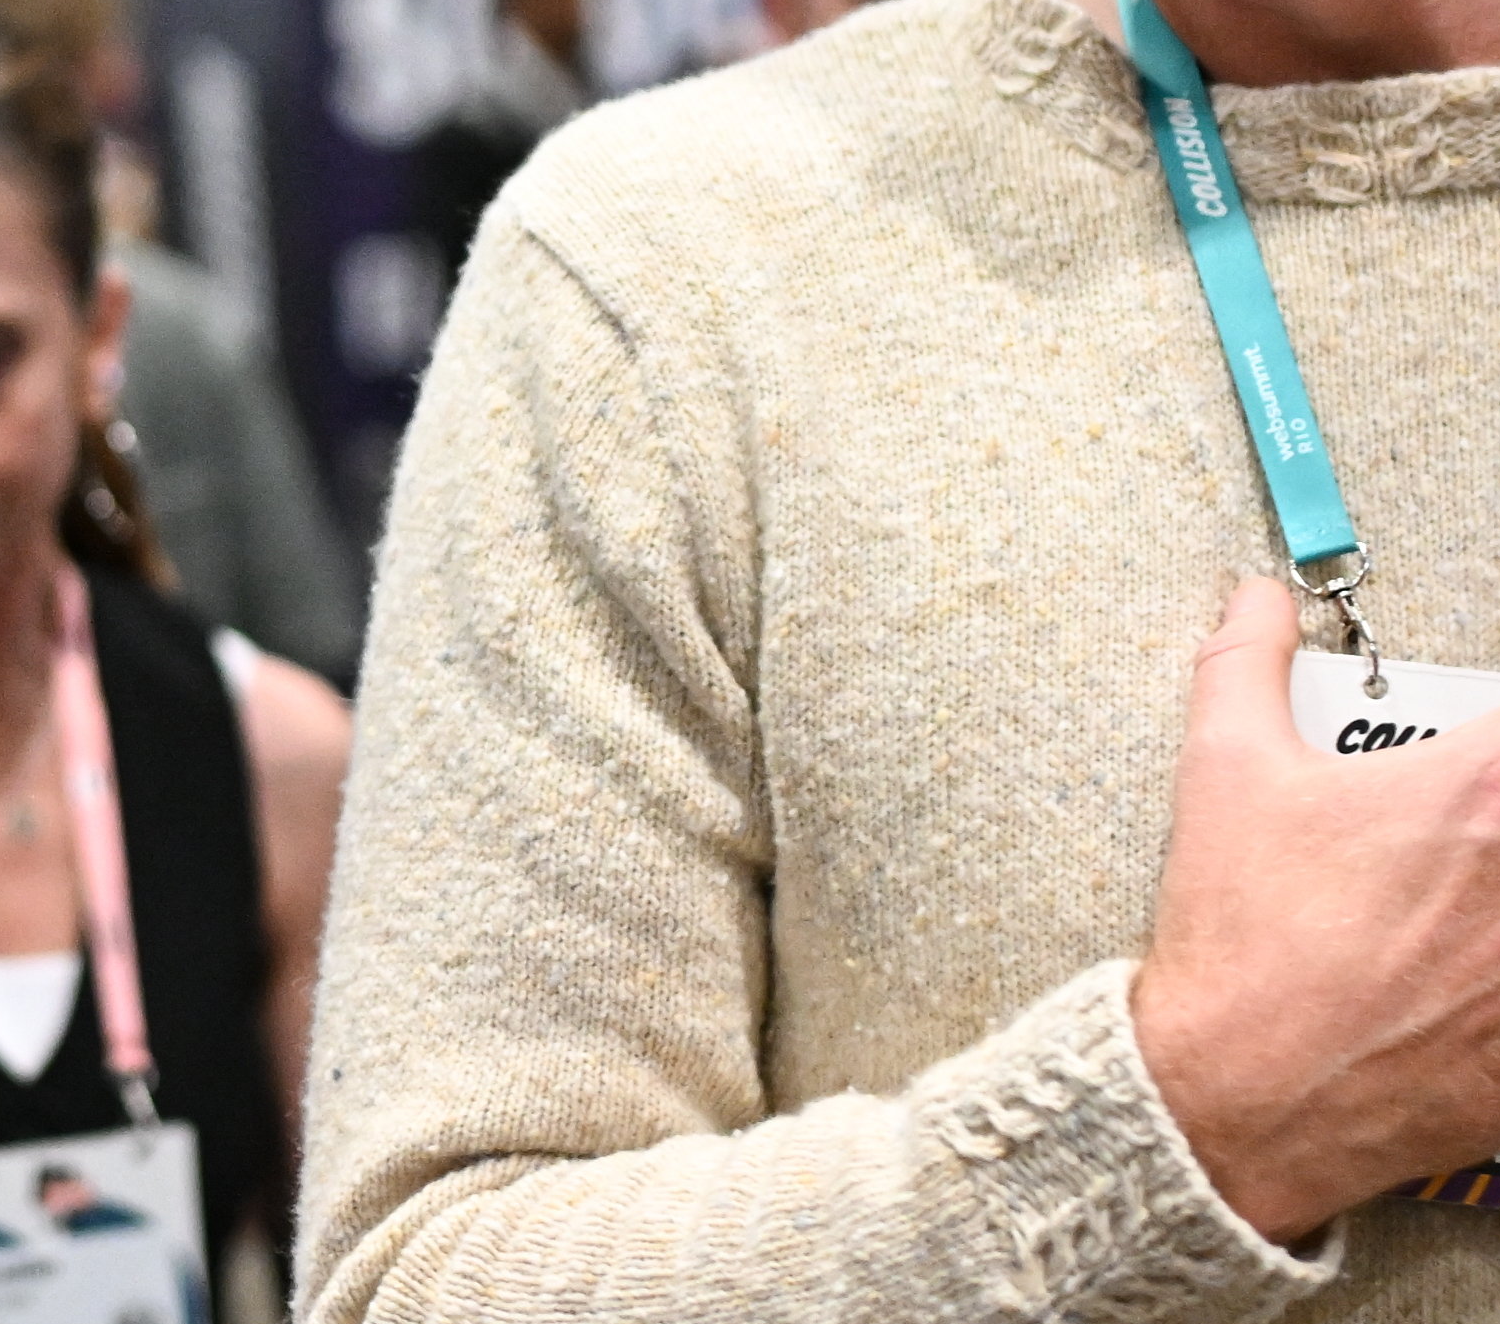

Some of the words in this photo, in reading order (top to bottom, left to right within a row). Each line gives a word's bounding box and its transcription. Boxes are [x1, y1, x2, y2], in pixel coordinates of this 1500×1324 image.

[1164, 97, 1228, 218] COLLISION
[1243, 342, 1295, 462] websummit
[1289, 417, 1315, 455] RIO
